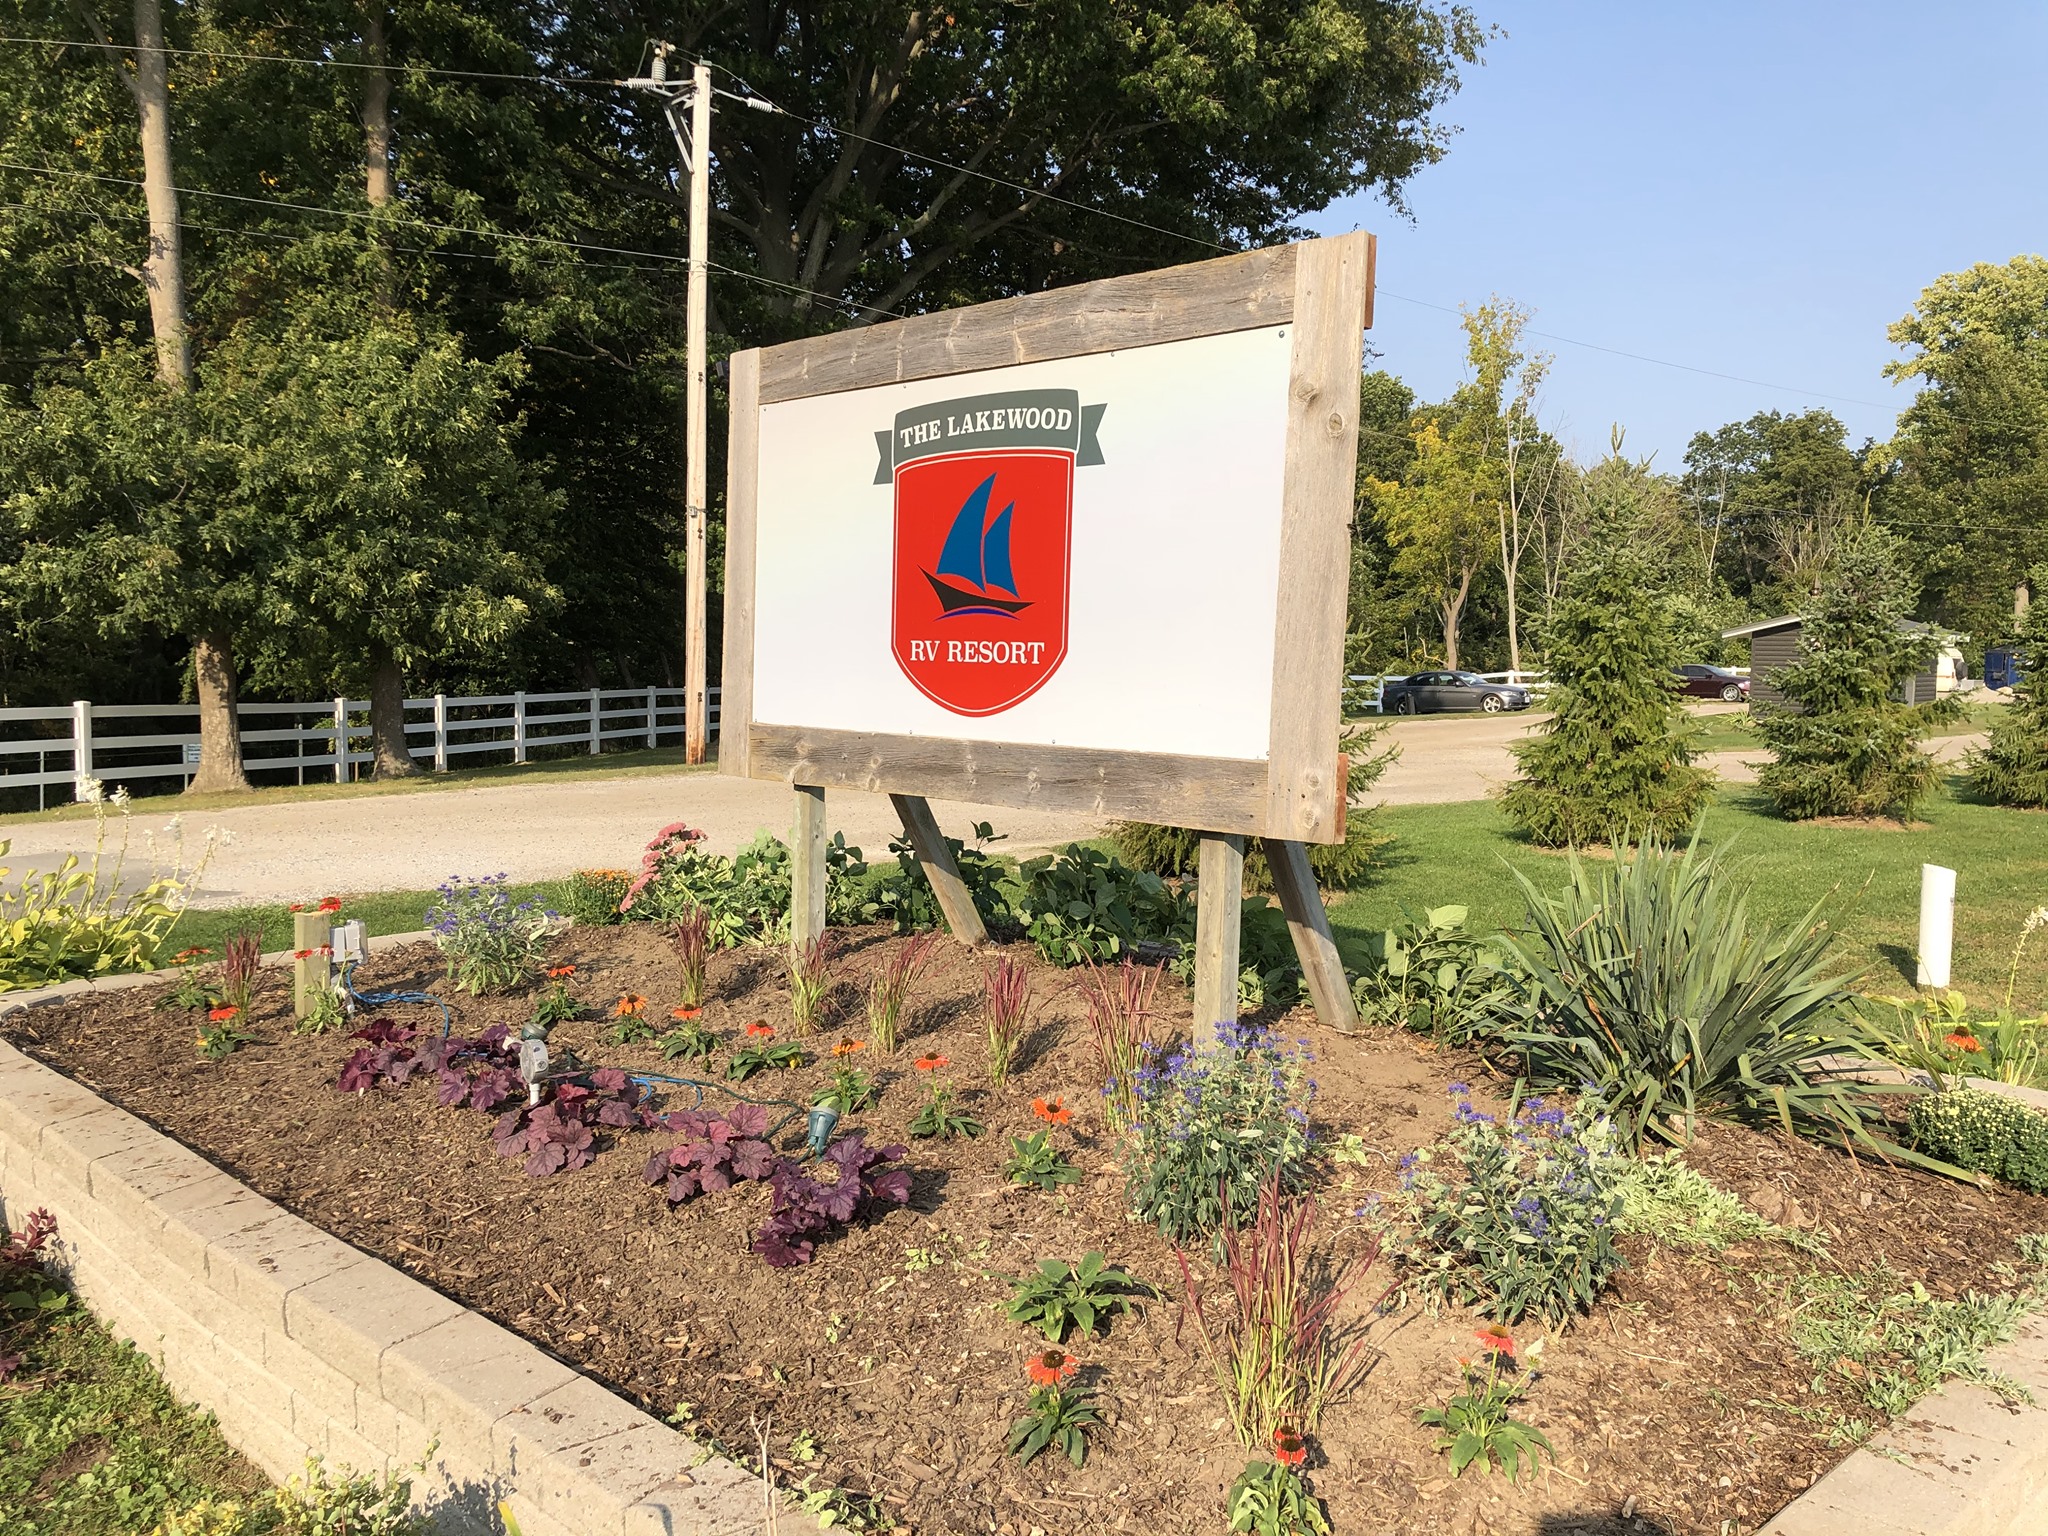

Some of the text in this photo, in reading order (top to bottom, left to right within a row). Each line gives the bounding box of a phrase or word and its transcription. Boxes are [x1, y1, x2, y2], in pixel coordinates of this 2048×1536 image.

[900, 407, 1073, 448] THE LAKEWOOD
[910, 640, 1045, 664] RV RESORT
